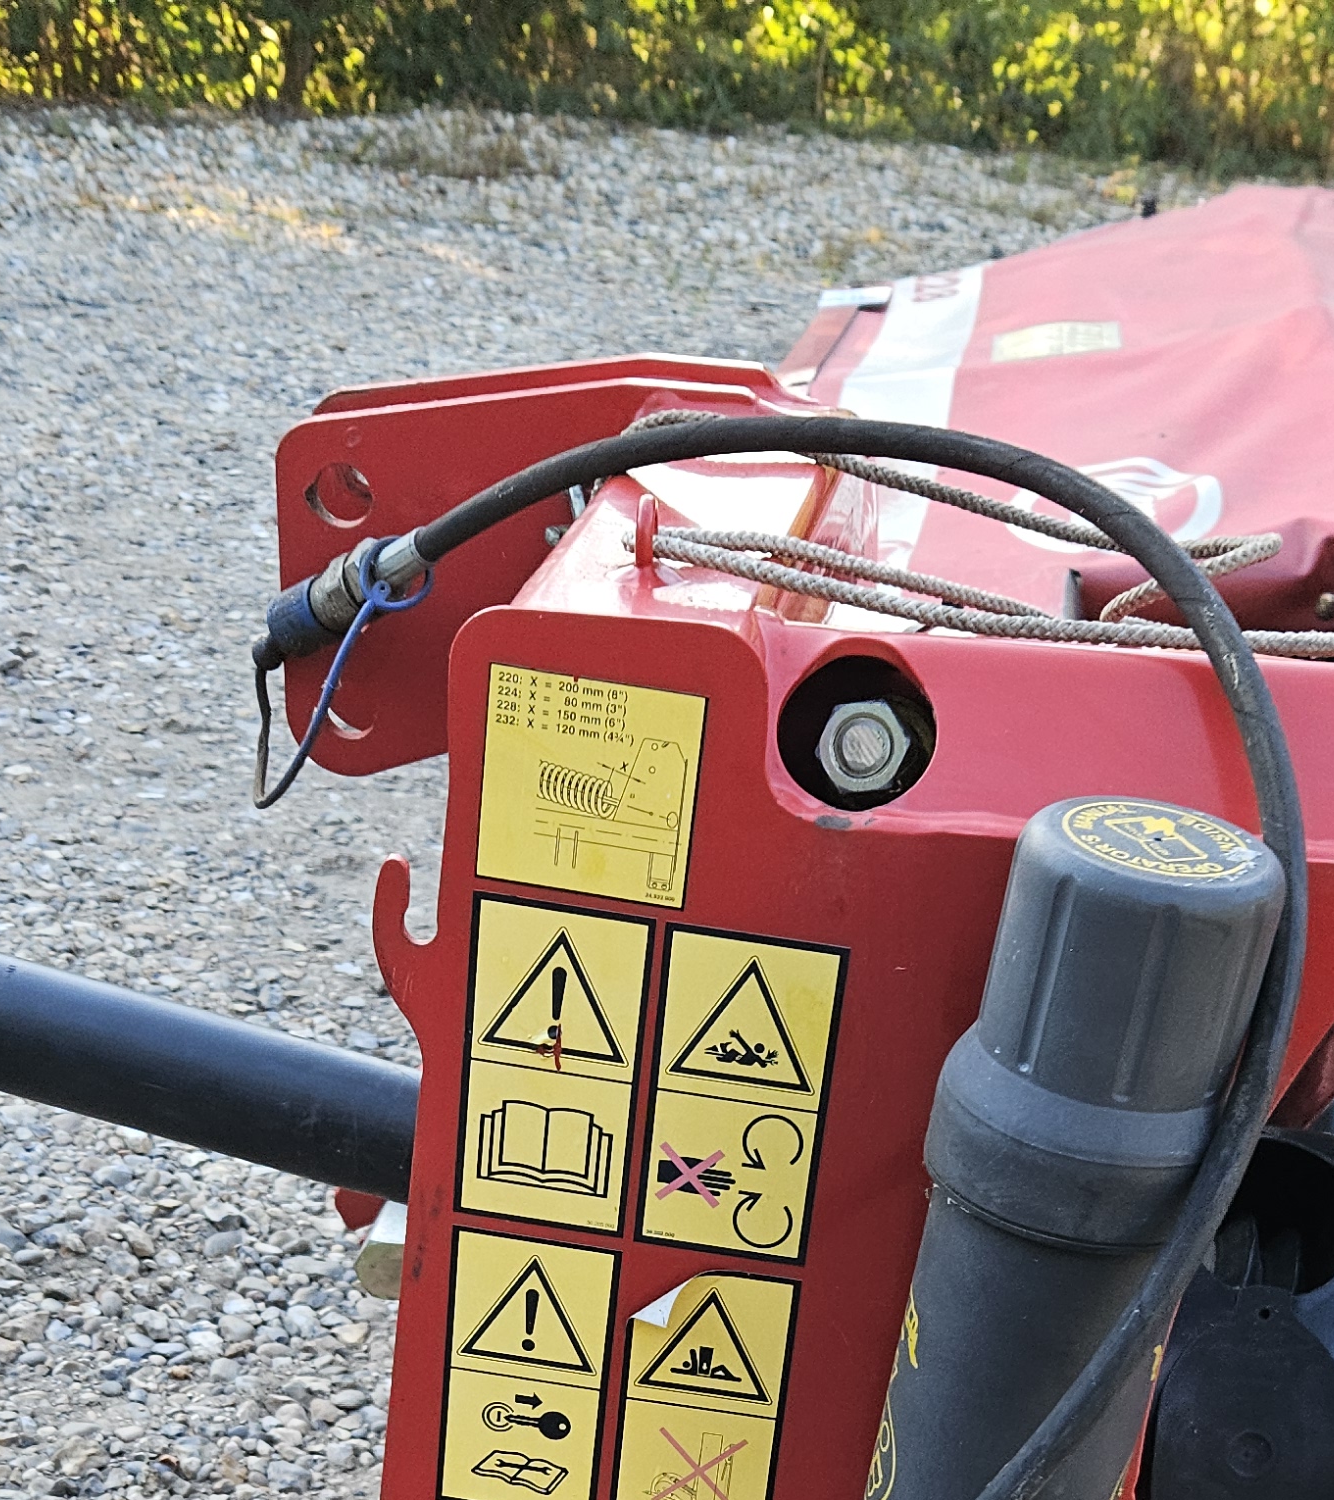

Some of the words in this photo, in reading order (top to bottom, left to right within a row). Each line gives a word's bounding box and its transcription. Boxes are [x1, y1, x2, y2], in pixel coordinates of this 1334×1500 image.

[498, 671, 523, 685] 220:
[530, 675, 538, 687] X
[558, 681, 579, 693] 200
[582, 686, 604, 698] mm
[497, 686, 522, 699] 224:
[529, 690, 537, 701] X
[564, 697, 578, 708] 80
[581, 701, 603, 712] mm
[496, 700, 521, 713] 228:
[527, 704, 536, 715] X
[557, 709, 577, 722] 150
[579, 715, 601, 726] mm
[495, 714, 519, 727] 232:
[526, 718, 535, 729] X
[556, 723, 575, 735] 120
[578, 729, 600, 740] mm
[619, 761, 629, 772] X
